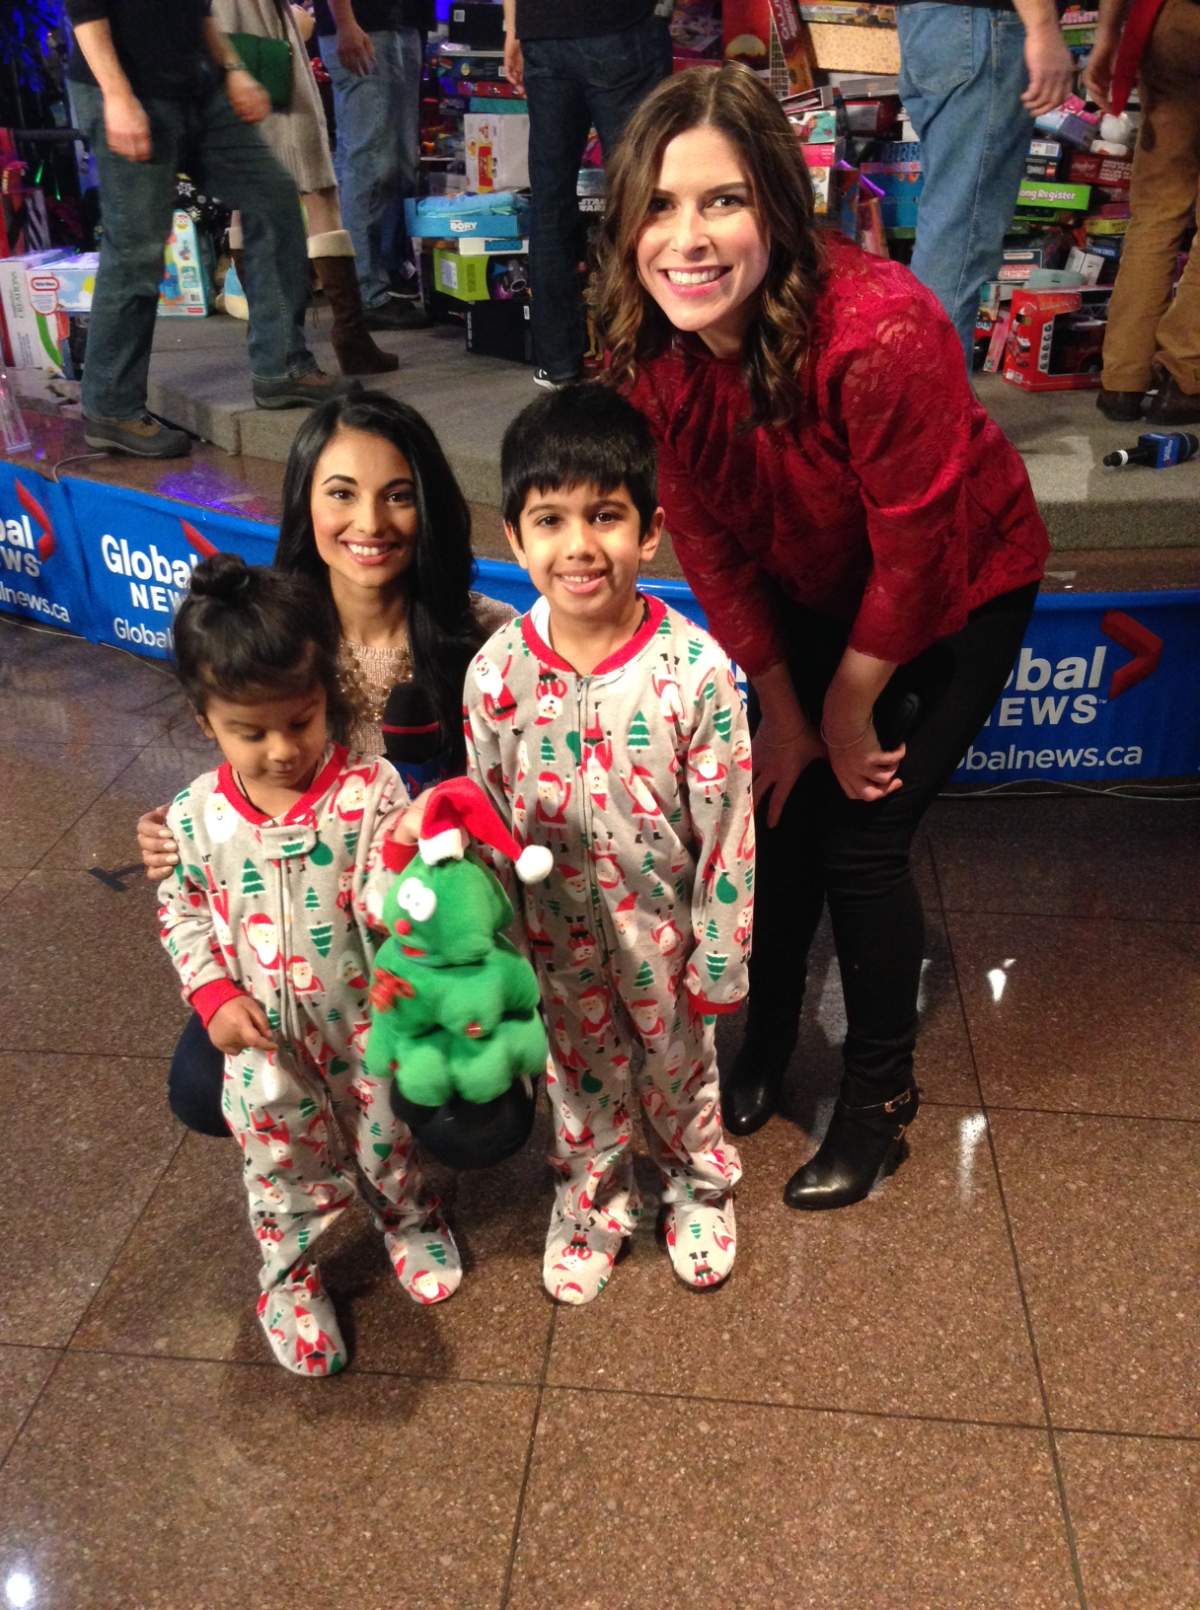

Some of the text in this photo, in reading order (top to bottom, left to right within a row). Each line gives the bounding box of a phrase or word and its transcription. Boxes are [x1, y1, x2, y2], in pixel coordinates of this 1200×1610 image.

[0, 546, 40, 577] WS
[1004, 646, 1107, 691] bal
[984, 694, 1098, 726] EWS
[957, 744, 1144, 770] balnews.ca
